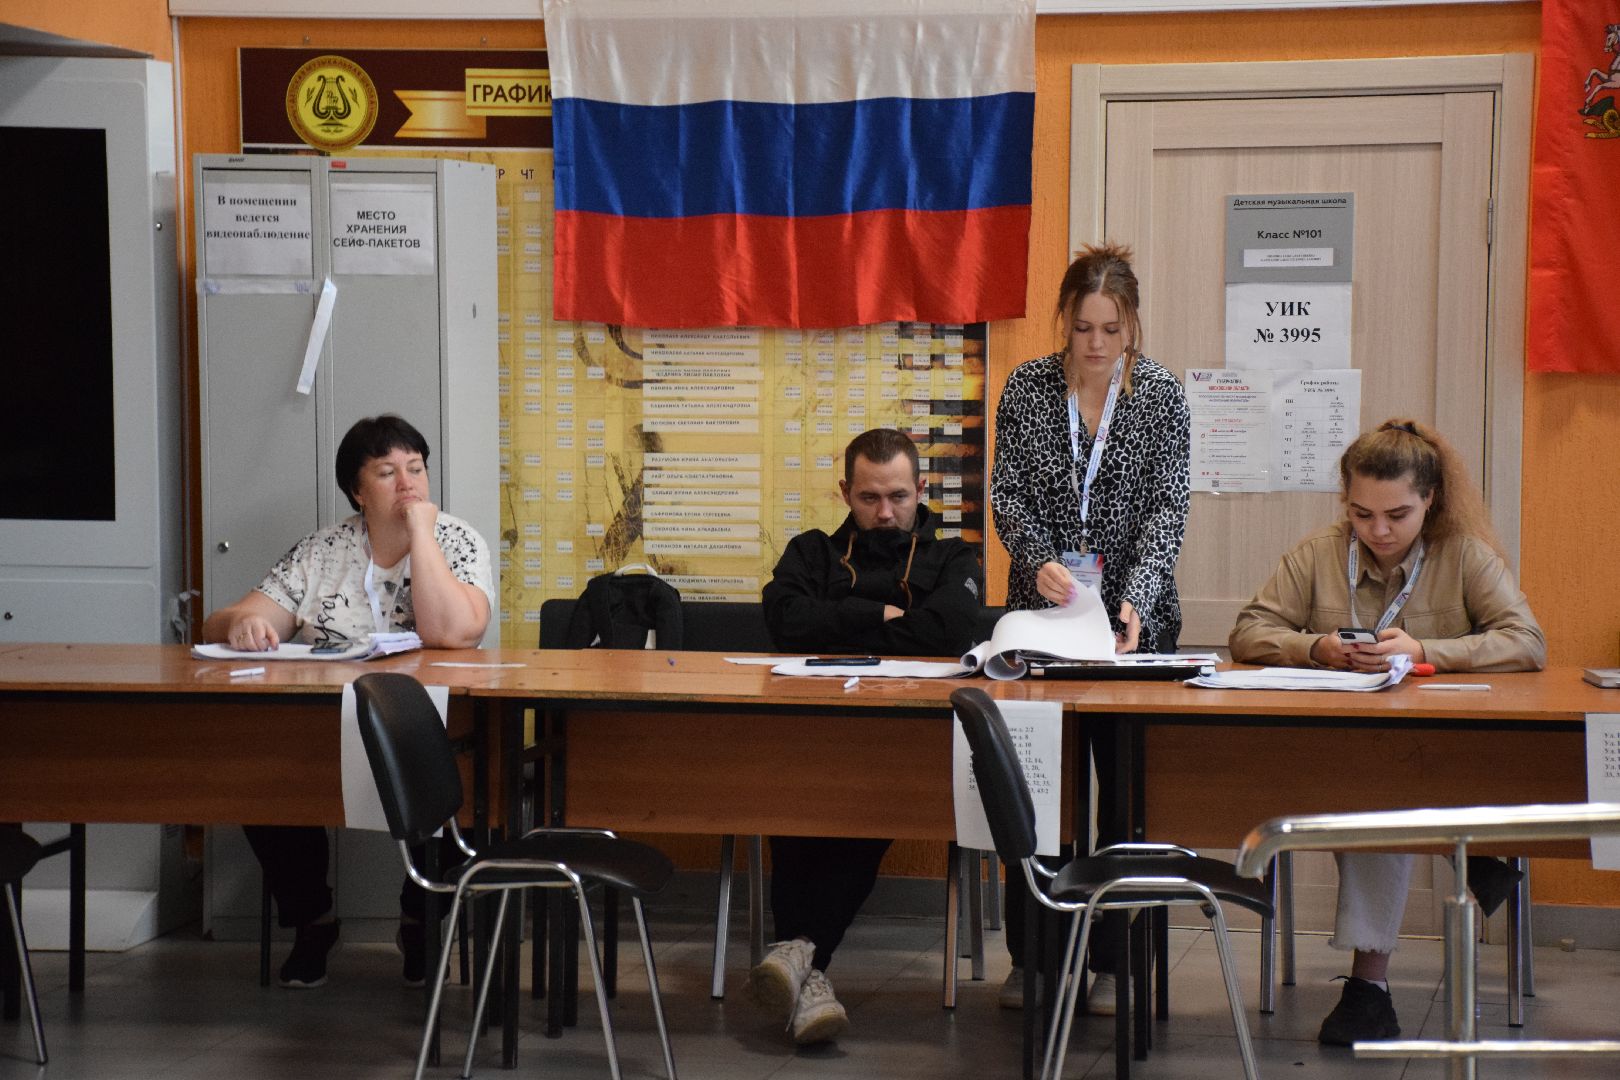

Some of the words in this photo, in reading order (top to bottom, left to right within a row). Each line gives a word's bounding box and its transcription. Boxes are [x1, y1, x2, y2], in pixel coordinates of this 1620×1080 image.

[472, 83, 552, 103] ГРАФИК
[496, 168, 506, 180] Р
[520, 168, 534, 180] ЧТ
[217, 196, 226, 206] В
[229, 198, 297, 208] помещении
[1233, 198, 1266, 207] Детская
[1267, 198, 1320, 206] музыкальная
[1321, 196, 1347, 204] школа
[235, 214, 280, 223] ведется
[356, 210, 396, 220] МЕСТО
[346, 224, 407, 234] ХРАНЕНИЯ
[1257, 230, 1290, 239] Класс
[1292, 230, 1322, 239] №101
[206, 229, 310, 242] видеонаблюдение
[333, 236, 420, 248] СЕЙФ-ПАКЕТОВ
[1265, 302, 1311, 316] УИК
[1254, 328, 1274, 343] №
[1279, 328, 1321, 343] 3995
